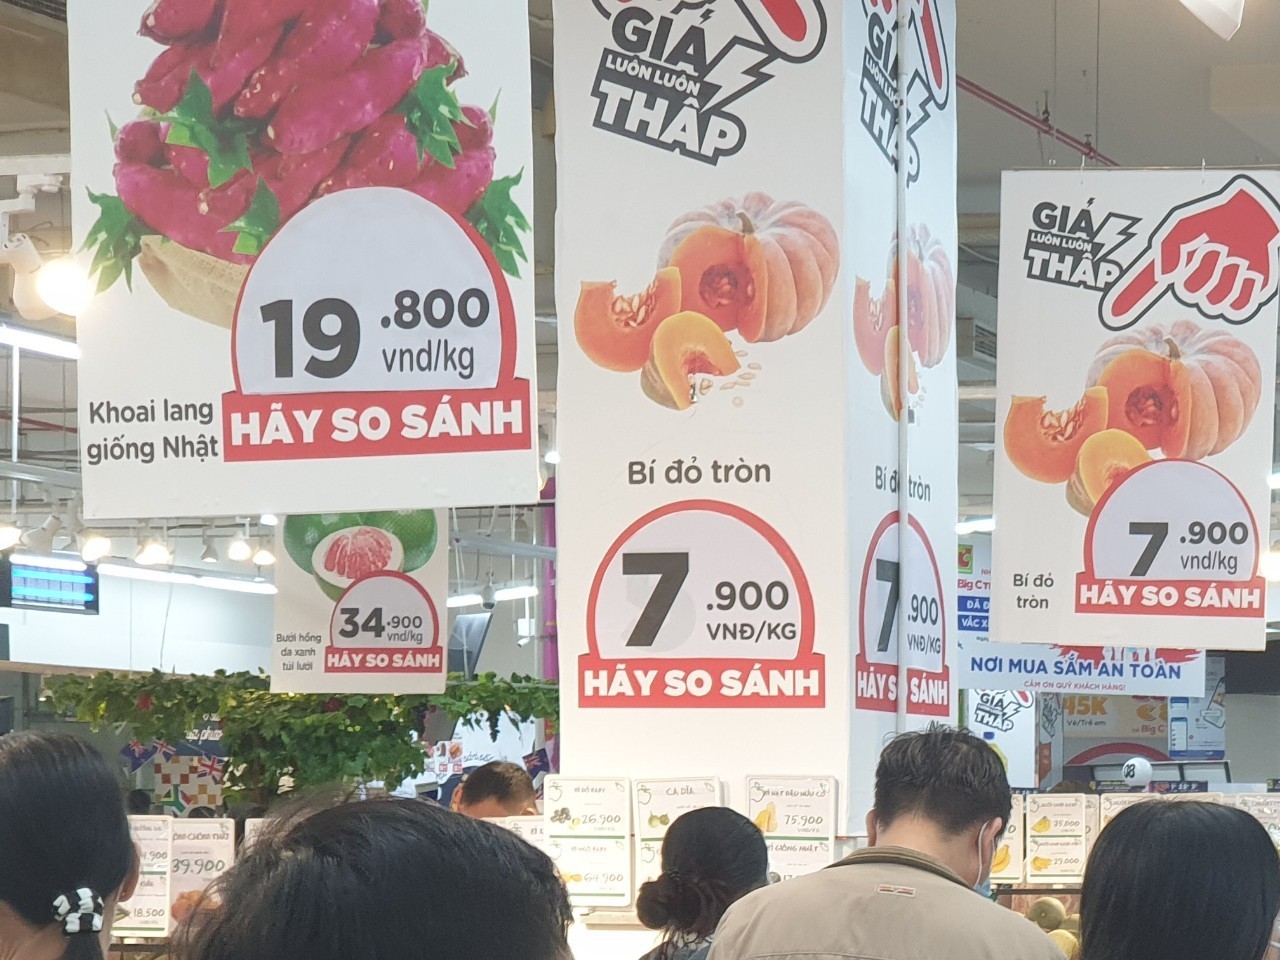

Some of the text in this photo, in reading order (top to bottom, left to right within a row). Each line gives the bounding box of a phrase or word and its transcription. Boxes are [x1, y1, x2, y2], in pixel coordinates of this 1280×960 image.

[611, 5, 713, 74] GIÁ
[605, 54, 701, 96] LUÔN LUÔN
[1032, 198, 1096, 239] GIÁ
[1030, 232, 1092, 254] LUÔN LUÔN
[381, 287, 490, 329] .800
[260, 297, 362, 379] 19
[382, 340, 475, 380] vnd/kg
[88, 398, 214, 430] Khoai lang
[230, 395, 523, 446] HÃY SO SÁNH
[87, 435, 218, 464] giống Nhật
[627, 456, 771, 485] Bí đỏ tròn
[875, 465, 931, 502] Bí tròn
[1179, 521, 1249, 545] .900
[1129, 521, 1169, 577] 7
[1180, 551, 1238, 576] vnd/kg
[1013, 572, 1054, 588] Bí đỏ
[622, 552, 689, 648] 7
[706, 581, 789, 611] .900
[876, 558, 900, 653] 7
[1016, 594, 1049, 610] tròn
[1080, 582, 1261, 609] HÃY SO SÁNH
[338, 607, 385, 638] 34
[387, 630, 423, 644] vnd/kg
[706, 619, 797, 643] VNĐ/KG
[281, 648, 316, 657] da xanh
[906, 633, 941, 655] VNĐ/KG
[327, 650, 440, 668] HÃY SO SÁNH
[971, 653, 1181, 679] NƠI MUA SẮM AN TOÀN
[583, 663, 820, 698] HÃY SO SÁNH
[857, 666, 949, 707] HÃY SÁNH
[1057, 680, 1072, 690] QUÝ
[1074, 682, 1100, 690] KHÁCH
[1141, 724, 1156, 735] Big
